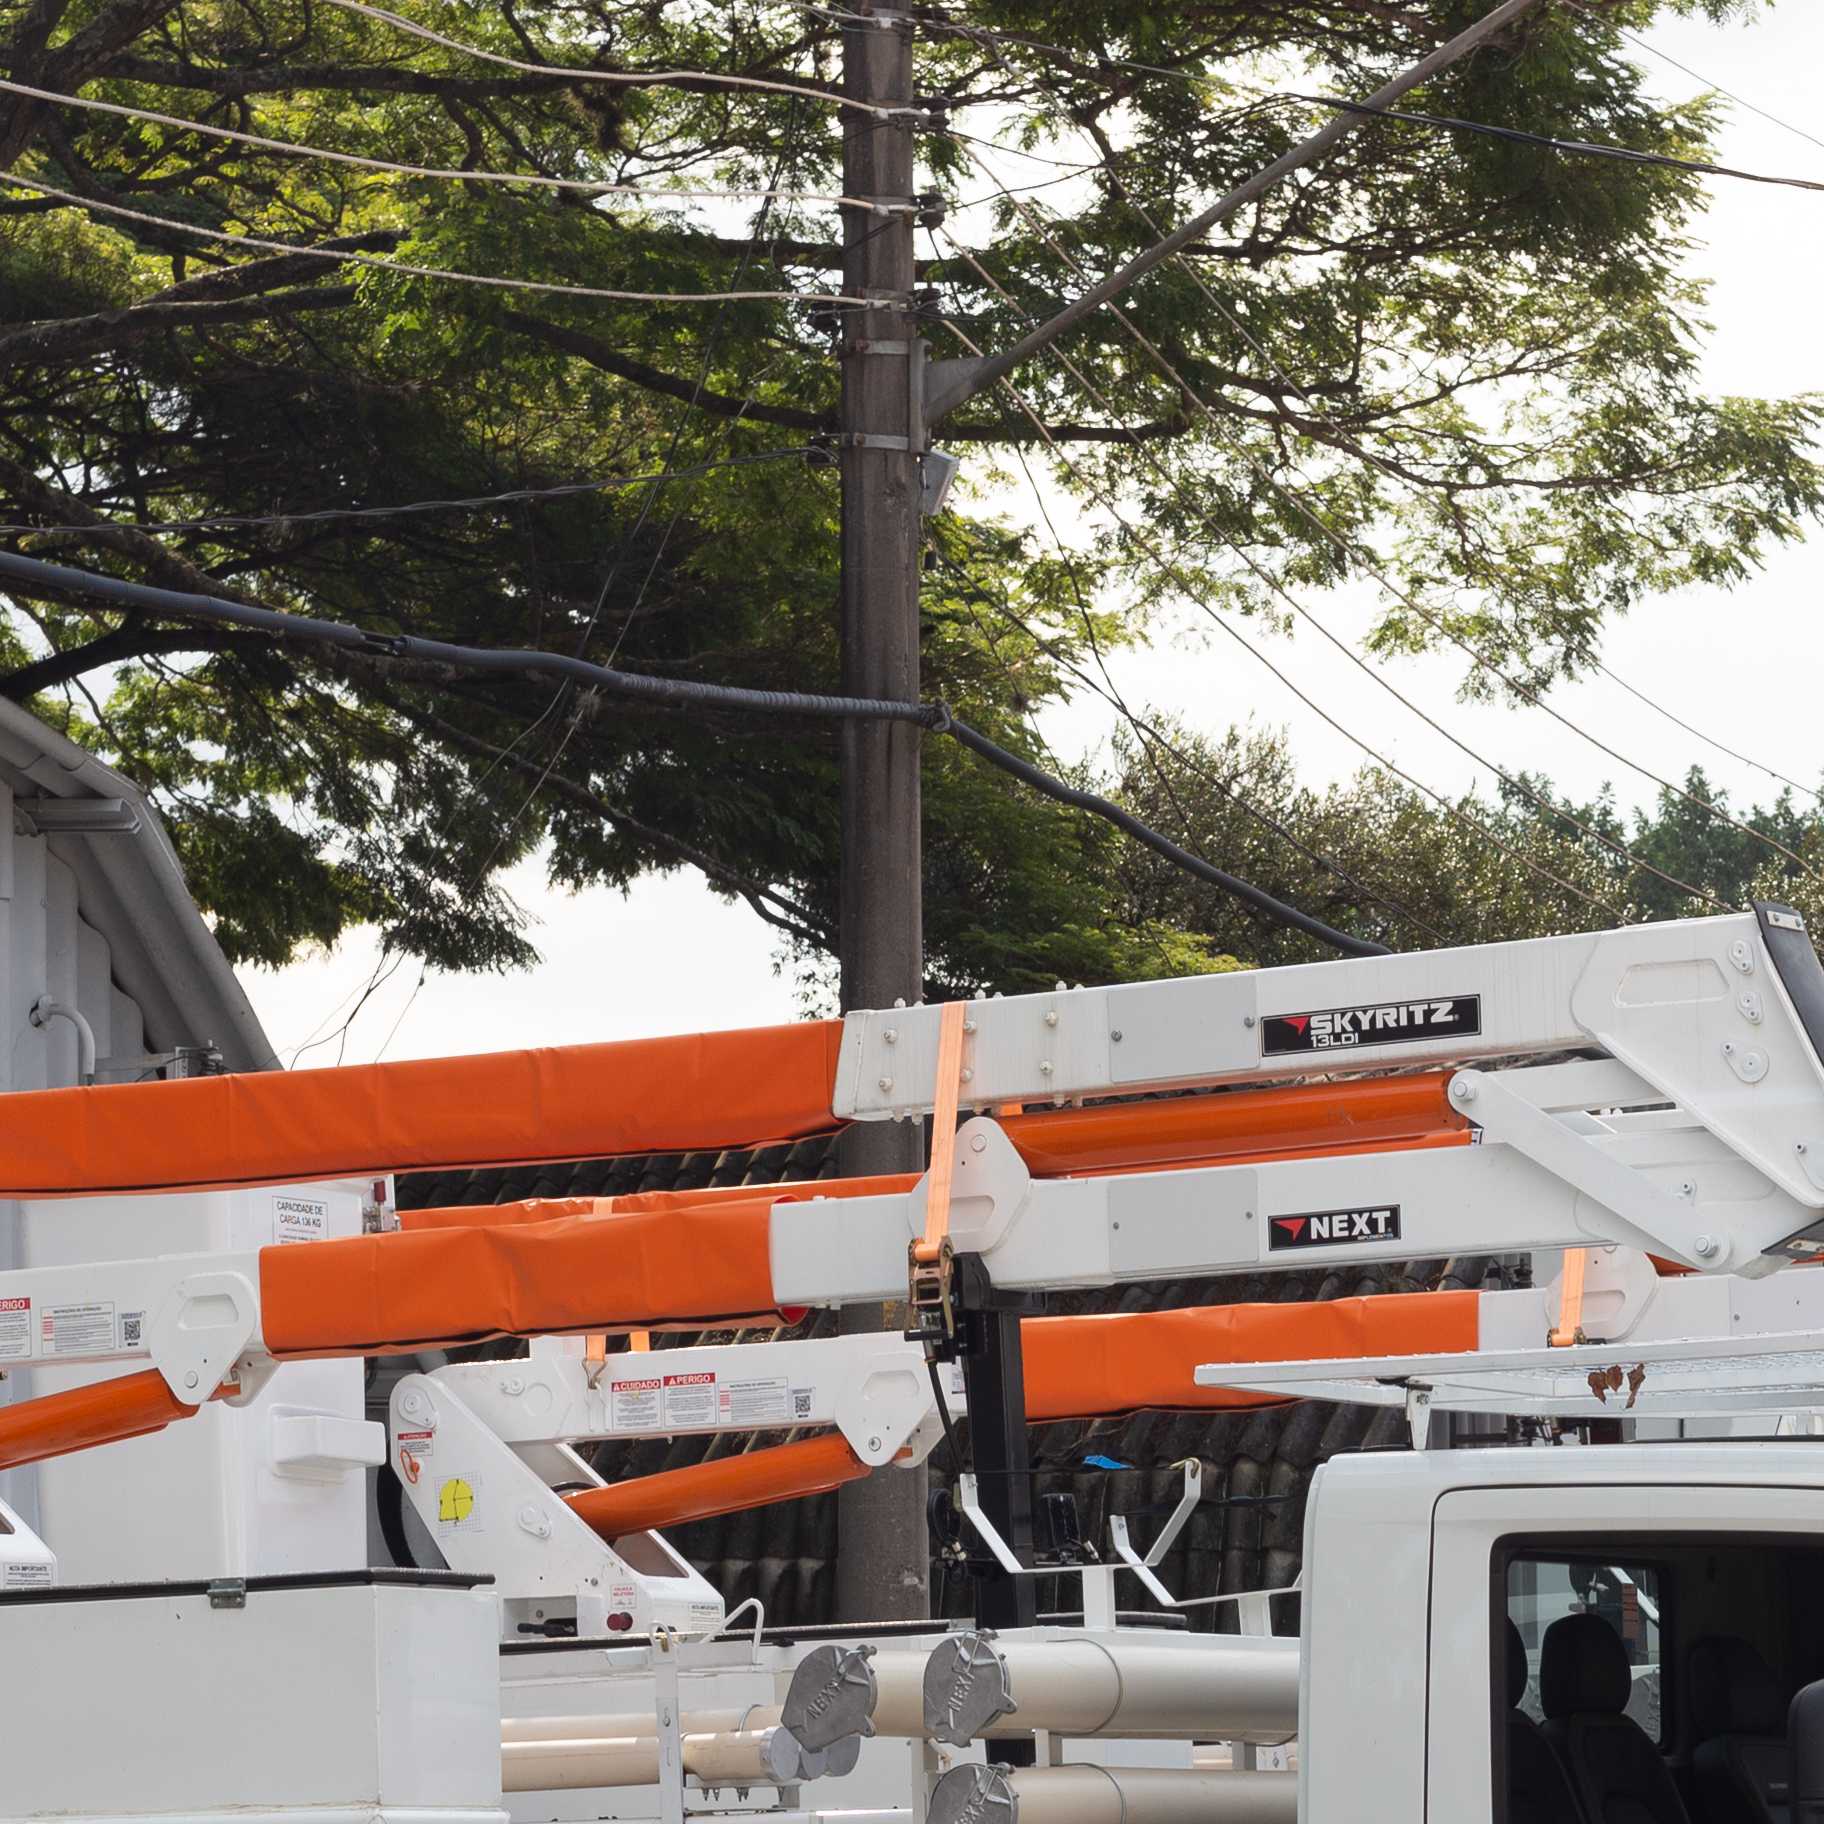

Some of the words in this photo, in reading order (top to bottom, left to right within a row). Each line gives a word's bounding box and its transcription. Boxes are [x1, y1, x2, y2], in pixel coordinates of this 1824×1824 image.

[1310, 1001, 1454, 1036] SKYRITZ
[1310, 1032, 1359, 1048] 13LDI
[1310, 1210, 1391, 1240] NEXT
[676, 1374, 711, 1385] PERIGO
